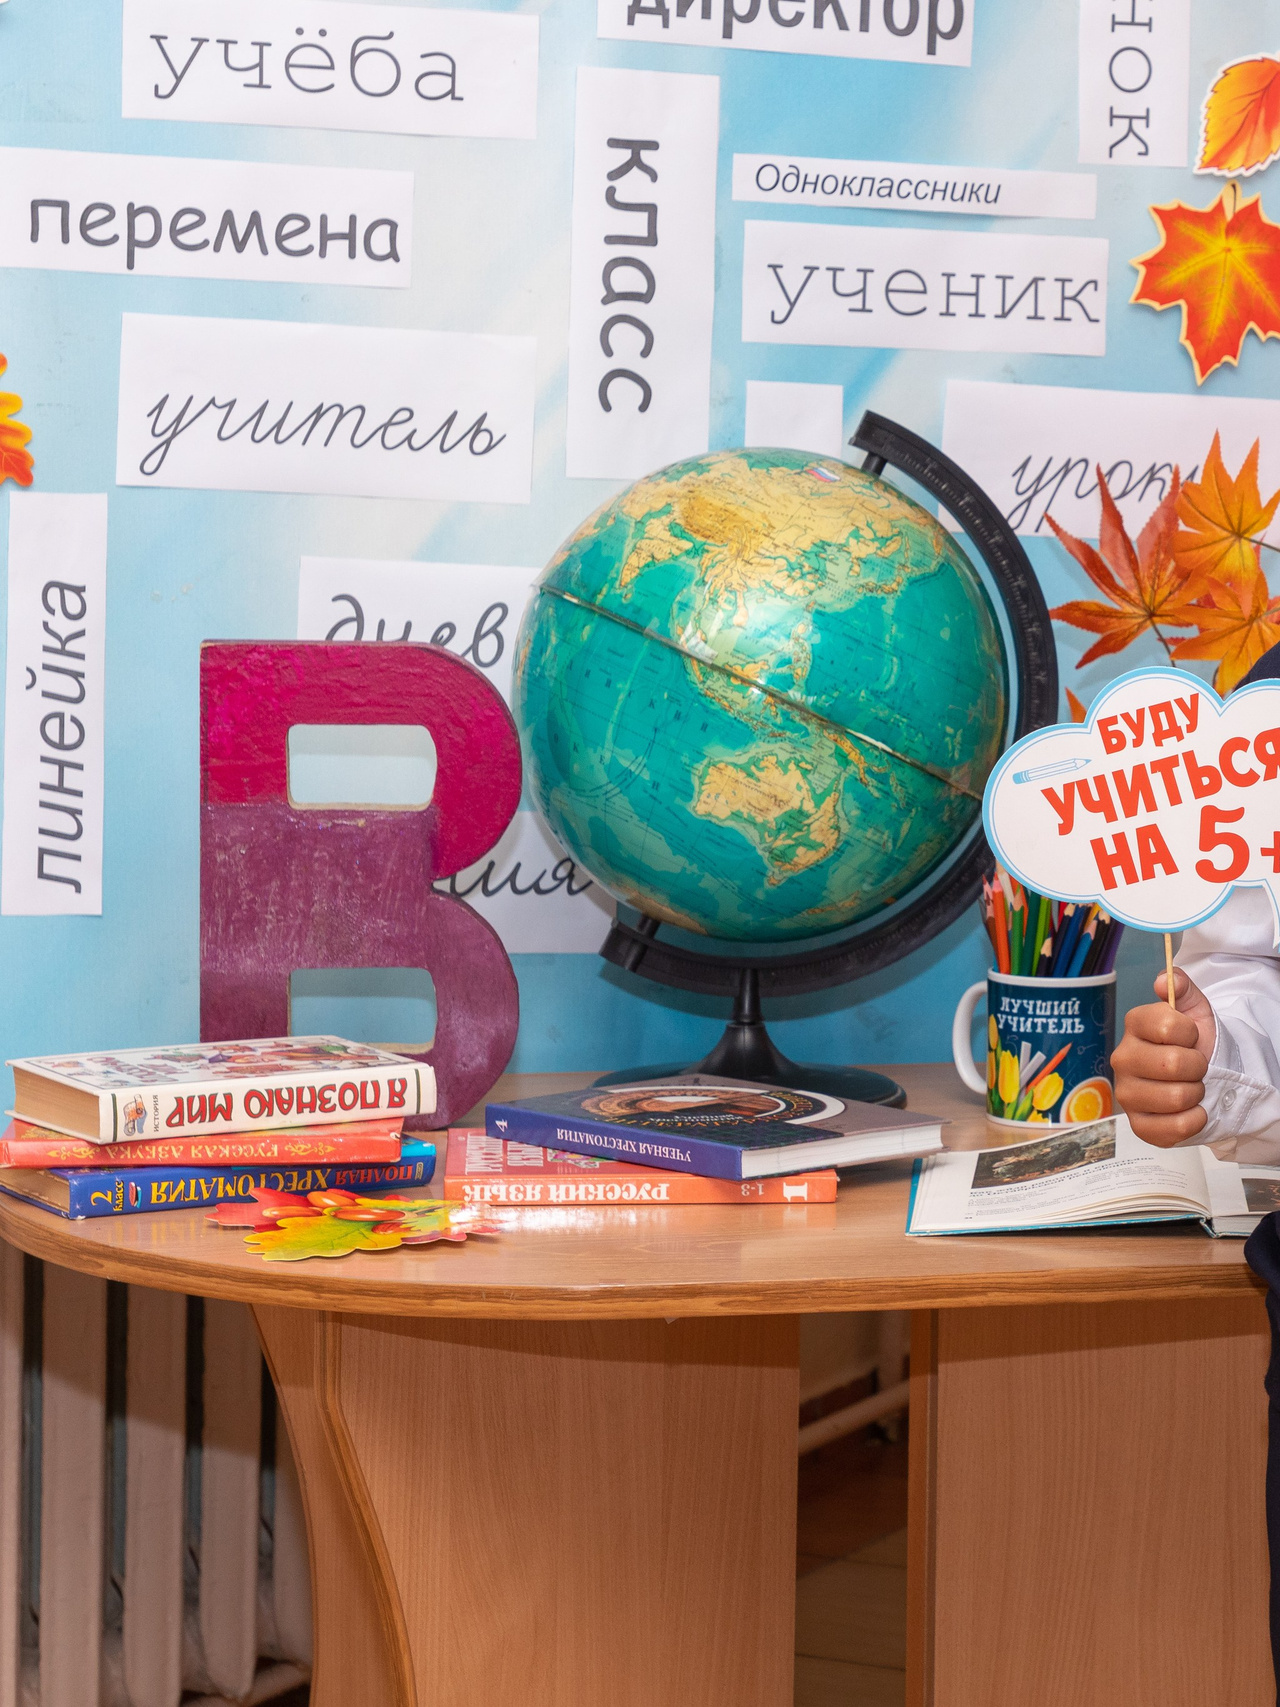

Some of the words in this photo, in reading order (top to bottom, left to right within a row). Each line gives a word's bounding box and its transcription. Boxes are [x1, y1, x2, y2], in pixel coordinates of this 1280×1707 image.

[150, 27, 464, 101] учёба
[755, 164, 1001, 205] Одноклассники
[30, 199, 401, 270] перемена
[598, 137, 660, 413] класс
[767, 264, 1100, 324] ученик
[139, 394, 507, 475] учитель
[25, 580, 87, 893] линейка
[1097, 693, 1200, 755] БУДУ
[1090, 823, 1179, 891] НА
[1000, 997, 1081, 1015] ЛУЧШИЙ
[997, 1013, 1085, 1034] УЧИТЕЛЬ
[244, 1079, 381, 1119] ПОЗНАЮ
[388, 1078, 408, 1109] Я
[152, 1094, 160, 1132] ИСТОРИЯ
[166, 1091, 234, 1128] МИР
[495, 1119, 508, 1132] 4
[556, 1128, 637, 1153] ХРЕСТОМАТИЯ
[105, 1144, 184, 1160] АЗБУКА
[190, 1143, 278, 1159] РУССКАЯ
[639, 1142, 691, 1162] УЧЕБНАЯ
[335, 1164, 412, 1185] ПОЛНАЯ
[741, 1182, 764, 1197] 1-3
[91, 1189, 112, 1206] 2
[462, 1184, 543, 1202] ЯЗЫК
[548, 1183, 669, 1202] РУССКИЙ
